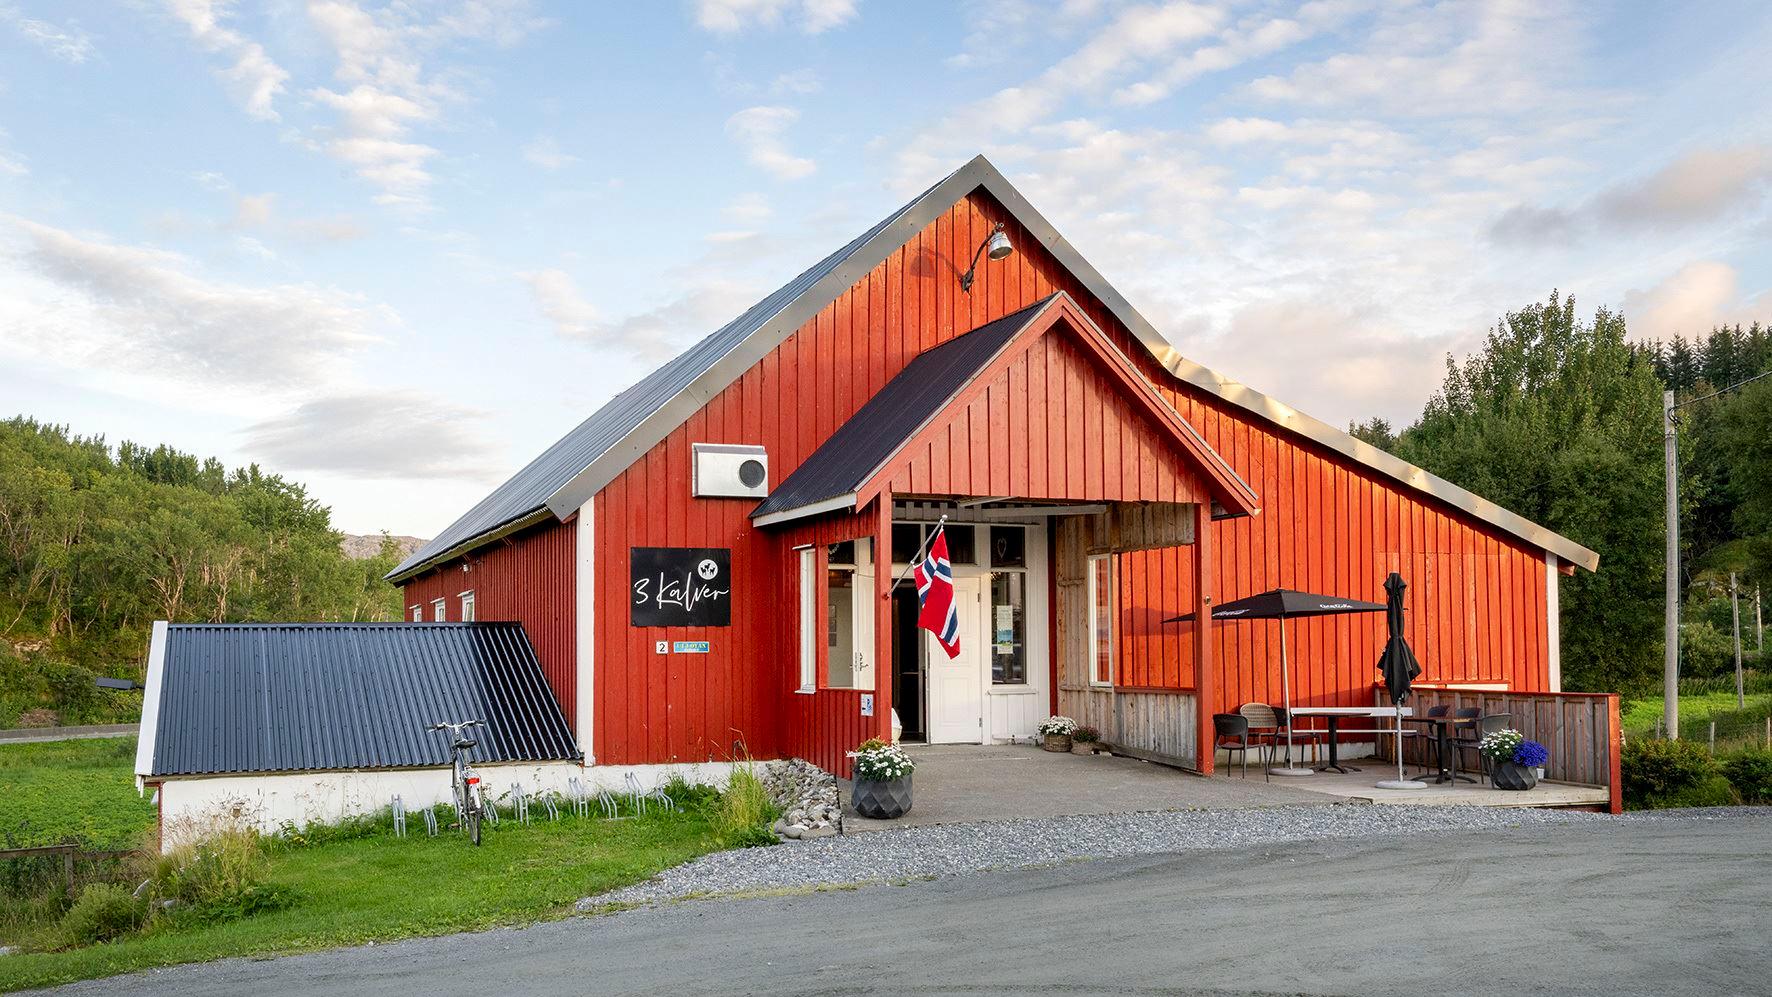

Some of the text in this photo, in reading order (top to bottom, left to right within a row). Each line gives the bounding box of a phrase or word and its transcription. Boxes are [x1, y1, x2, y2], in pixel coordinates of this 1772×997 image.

[634, 572, 729, 611] 3 Kalver
[659, 643, 666, 652] 2
